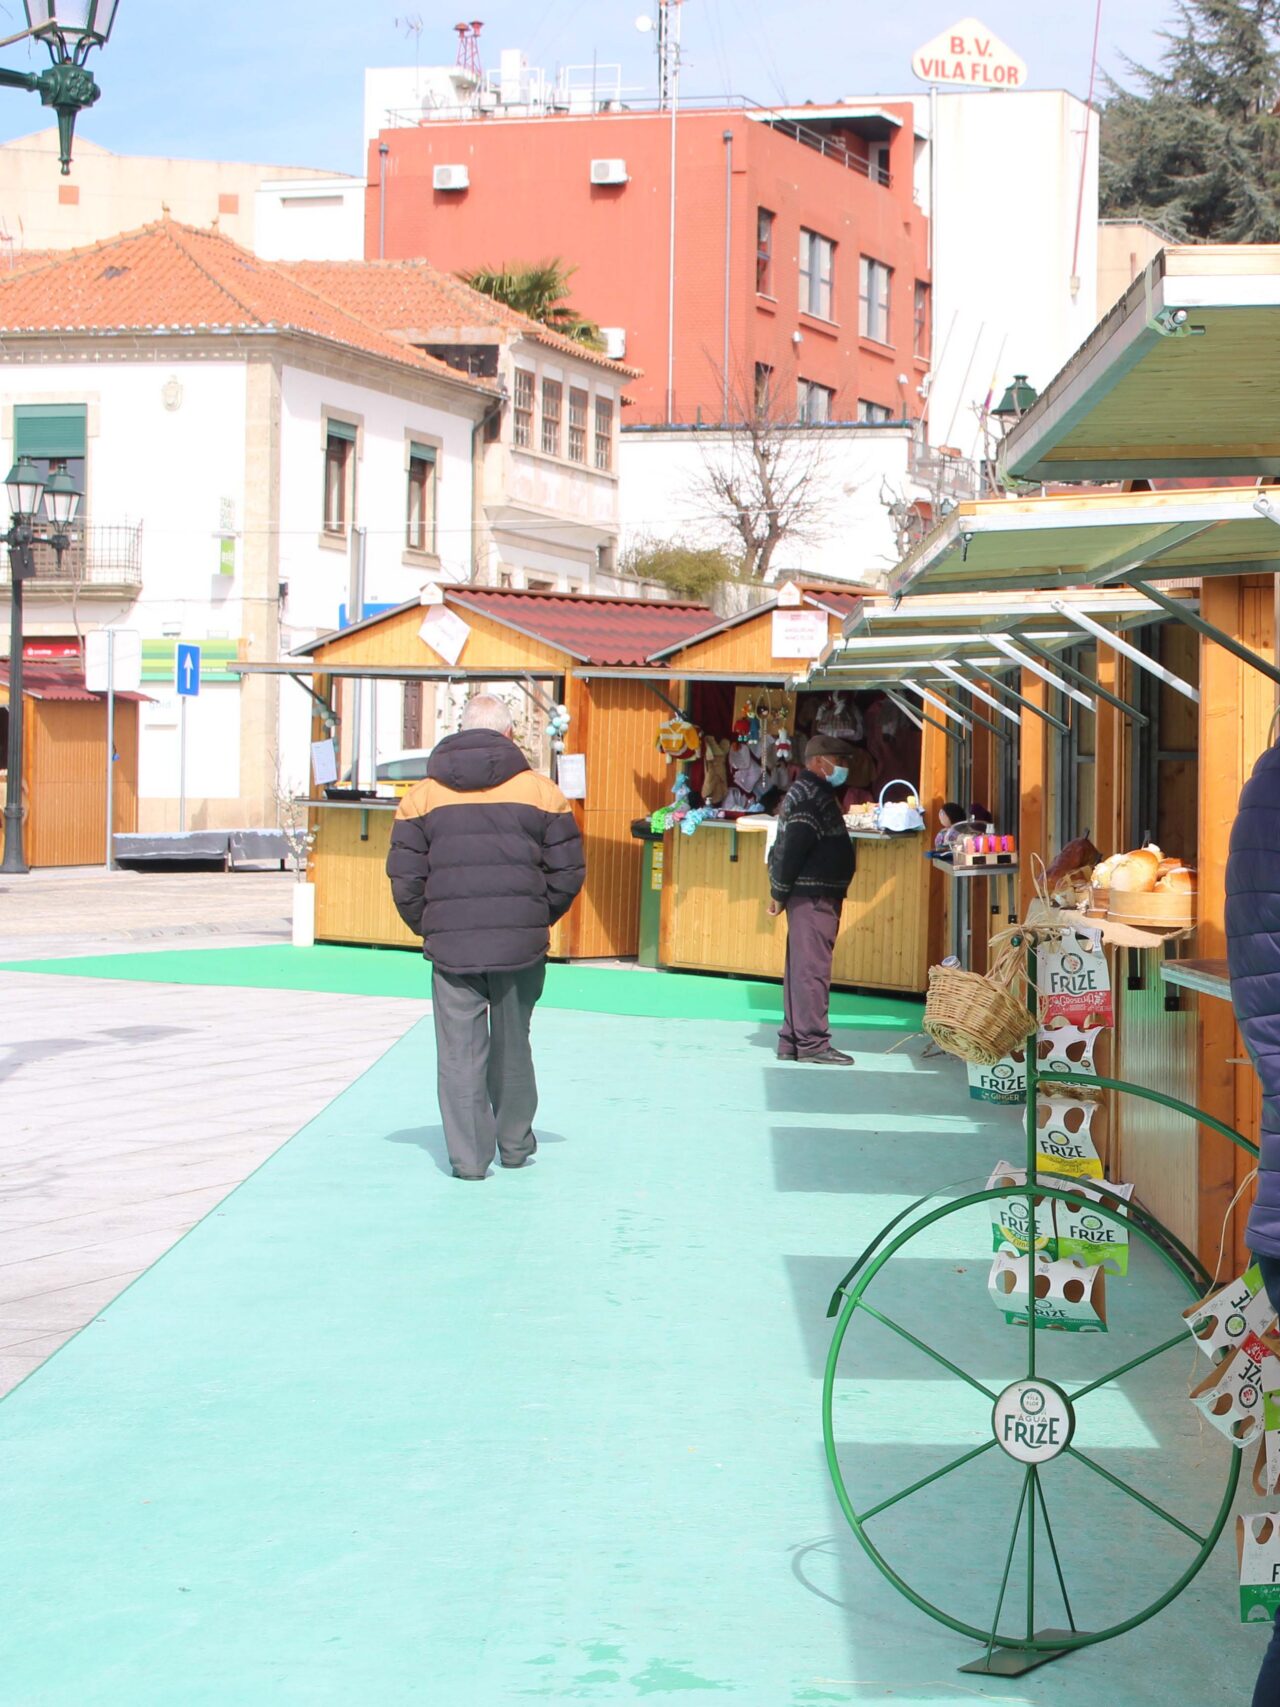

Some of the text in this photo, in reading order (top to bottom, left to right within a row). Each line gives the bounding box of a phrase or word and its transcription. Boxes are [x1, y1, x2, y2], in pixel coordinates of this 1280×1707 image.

[950, 36, 993, 57] B.V.
[920, 58, 1019, 85] VILA FLOR
[1051, 970, 1097, 995] FRIZE
[981, 1075, 1026, 1094] FRIZE
[1040, 1141, 1087, 1159] FRIZE
[1070, 1225, 1116, 1244] FRIZE
[1004, 1414, 1060, 1449] FRIZE
